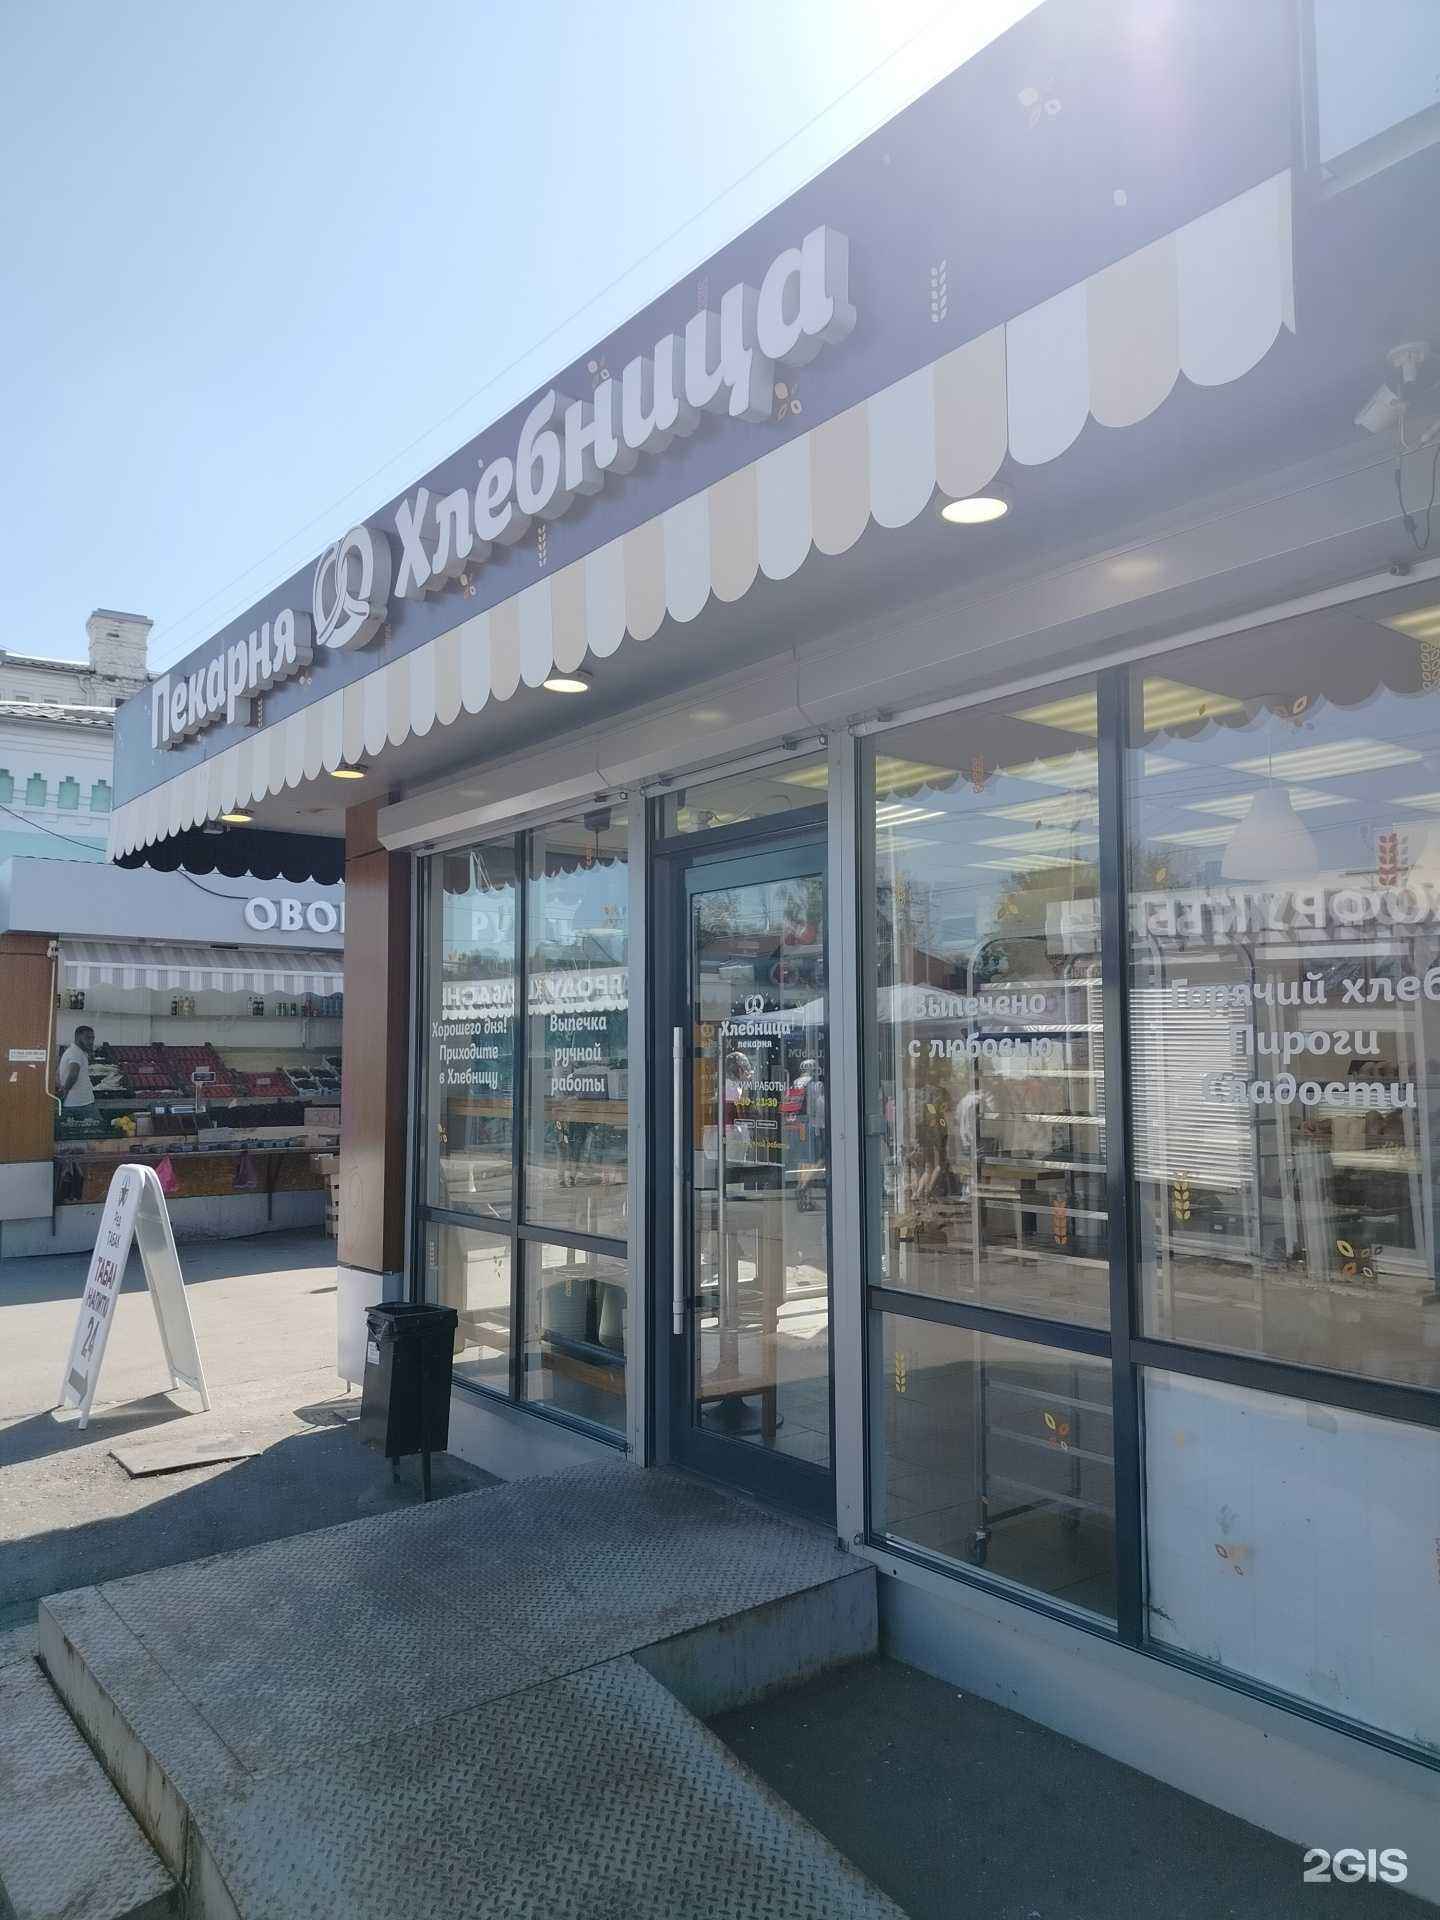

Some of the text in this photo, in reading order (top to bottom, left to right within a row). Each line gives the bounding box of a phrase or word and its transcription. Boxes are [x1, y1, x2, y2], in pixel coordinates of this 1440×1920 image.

[151, 224, 848, 750] Пекарня Хлебница
[244, 896, 345, 934] ОВО
[1171, 972, 1327, 1017] Горячий
[432, 1017, 507, 1041] Хорошего дня!
[550, 1014, 607, 1032] Выпечка
[721, 1020, 790, 1038] Хлебница
[440, 1043, 499, 1064] Приходите
[554, 1042, 602, 1067] ручной
[737, 1040, 772, 1051] пекарня
[908, 1032, 1053, 1058] с любовью
[1229, 1023, 1381, 1065] Пироги
[447, 1067, 499, 1090] Хлебницу
[551, 1072, 605, 1096] работы
[755, 1080, 785, 1091] РАБОТЫ
